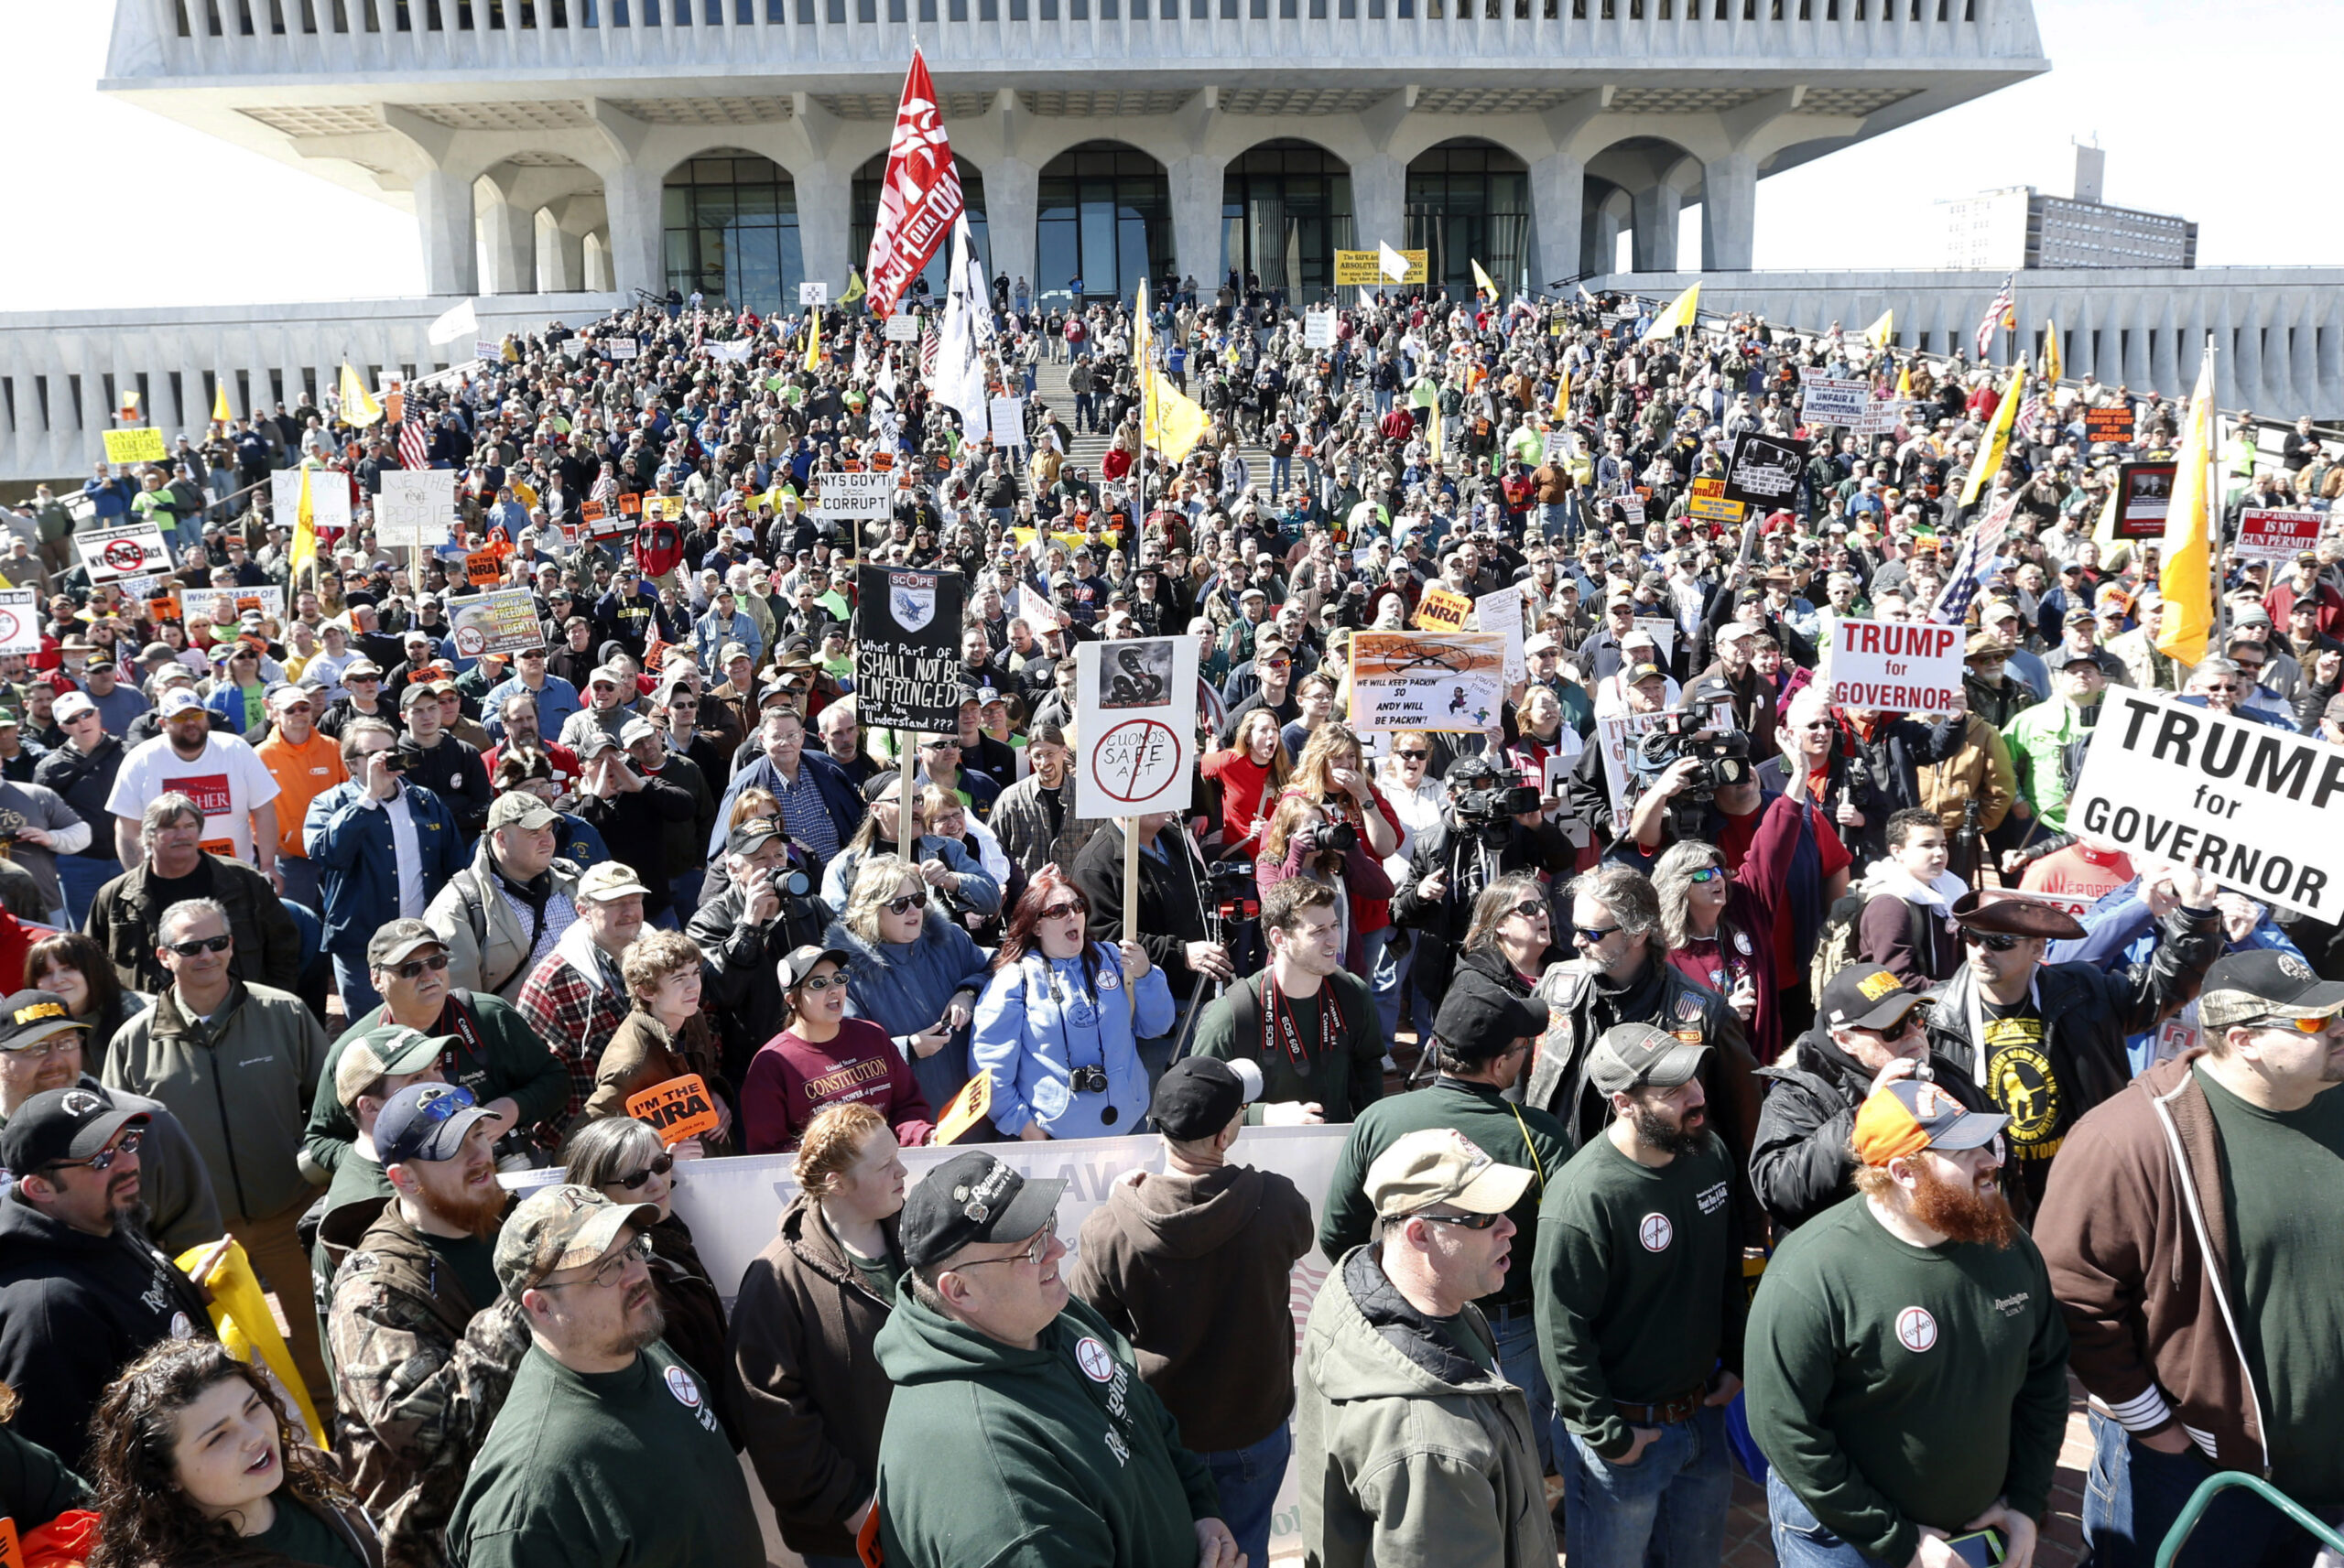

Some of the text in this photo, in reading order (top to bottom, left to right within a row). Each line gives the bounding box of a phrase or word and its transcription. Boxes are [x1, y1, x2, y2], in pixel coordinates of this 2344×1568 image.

[1816, 393, 1848, 401] UNFAIR
[1807, 403, 1862, 414] UNCONSTITUTIONAL
[2089, 408, 2132, 416] RANDOM
[2089, 433, 2132, 442] CUOMO
[874, 458, 892, 466] NRA
[387, 473, 452, 492] WE THE
[820, 474, 887, 487] NYS GOV'T
[1103, 482, 1126, 491] TRUM
[1613, 496, 1642, 504] PEAL
[1694, 488, 1722, 498] VIOLAT
[583, 507, 602, 516] NRA
[823, 497, 886, 510] CORRUPT
[385, 504, 454, 528] PEOPLE
[2246, 511, 2261, 519] THE
[2273, 514, 2323, 523] AMENDMENT
[2264, 521, 2298, 534] IS MY
[2241, 533, 2316, 549] GUN PERMIT!
[88, 555, 105, 568] NY
[105, 546, 141, 565] SAFE
[468, 564, 496, 577] NRA
[891, 574, 934, 587] SCOPE
[228, 589, 276, 600] PART OF
[1429, 594, 1465, 611] I'M THE
[493, 600, 514, 609] FIGHT
[494, 605, 535, 620] FREEDOM
[1023, 588, 1054, 620] TRUMP
[1422, 604, 1461, 625] NRA
[498, 620, 537, 635] LIBERTY
[859, 639, 891, 654] What
[898, 643, 928, 657] Part
[1842, 622, 1955, 658] TRUMP
[916, 657, 942, 683] NOT
[943, 659, 961, 685] BE
[1885, 659, 1907, 676] for
[414, 671, 439, 683] NRA
[1474, 674, 1497, 689] You're
[1394, 688, 1406, 697] SO
[1470, 682, 1491, 696] Fired!
[1835, 682, 1952, 710] GOVERNOR
[858, 698, 907, 715] Don't You
[1375, 702, 1424, 711] ANDY WILL
[865, 711, 953, 730] Understand ???
[1375, 715, 1427, 725] BE PACKIN'!
[1107, 730, 1166, 747] CUOMO'S
[2122, 697, 2344, 809] TRUMP
[1116, 764, 1156, 778] ACT
[2193, 784, 2241, 819] for
[2084, 796, 2328, 909] GOVERNOR
[14, 1002, 68, 1025] NRA
[1329, 999, 1340, 1028] Canon
[458, 1017, 475, 1044] Canon
[1265, 1011, 1274, 1046] EOS 5D
[1281, 1016, 1300, 1054] EOS 60D
[825, 1057, 857, 1072] United States
[805, 1058, 888, 1099] CONSTITUTION
[634, 1082, 700, 1115] I'M THE
[841, 1089, 864, 1104] POWER
[968, 1077, 982, 1118] NRA
[638, 1094, 711, 1130] NRA
[2029, 1136, 2064, 1160] YORK
[971, 1160, 1007, 1203] Reming
[992, 1178, 1006, 1199] ARMS
[1645, 1224, 1668, 1241] CUOMO
[1994, 1292, 2029, 1311] Remington
[1904, 1320, 1931, 1339] CUOMO
[1084, 1350, 1106, 1368] CUOMO
[1105, 1362, 1130, 1468] Regton
